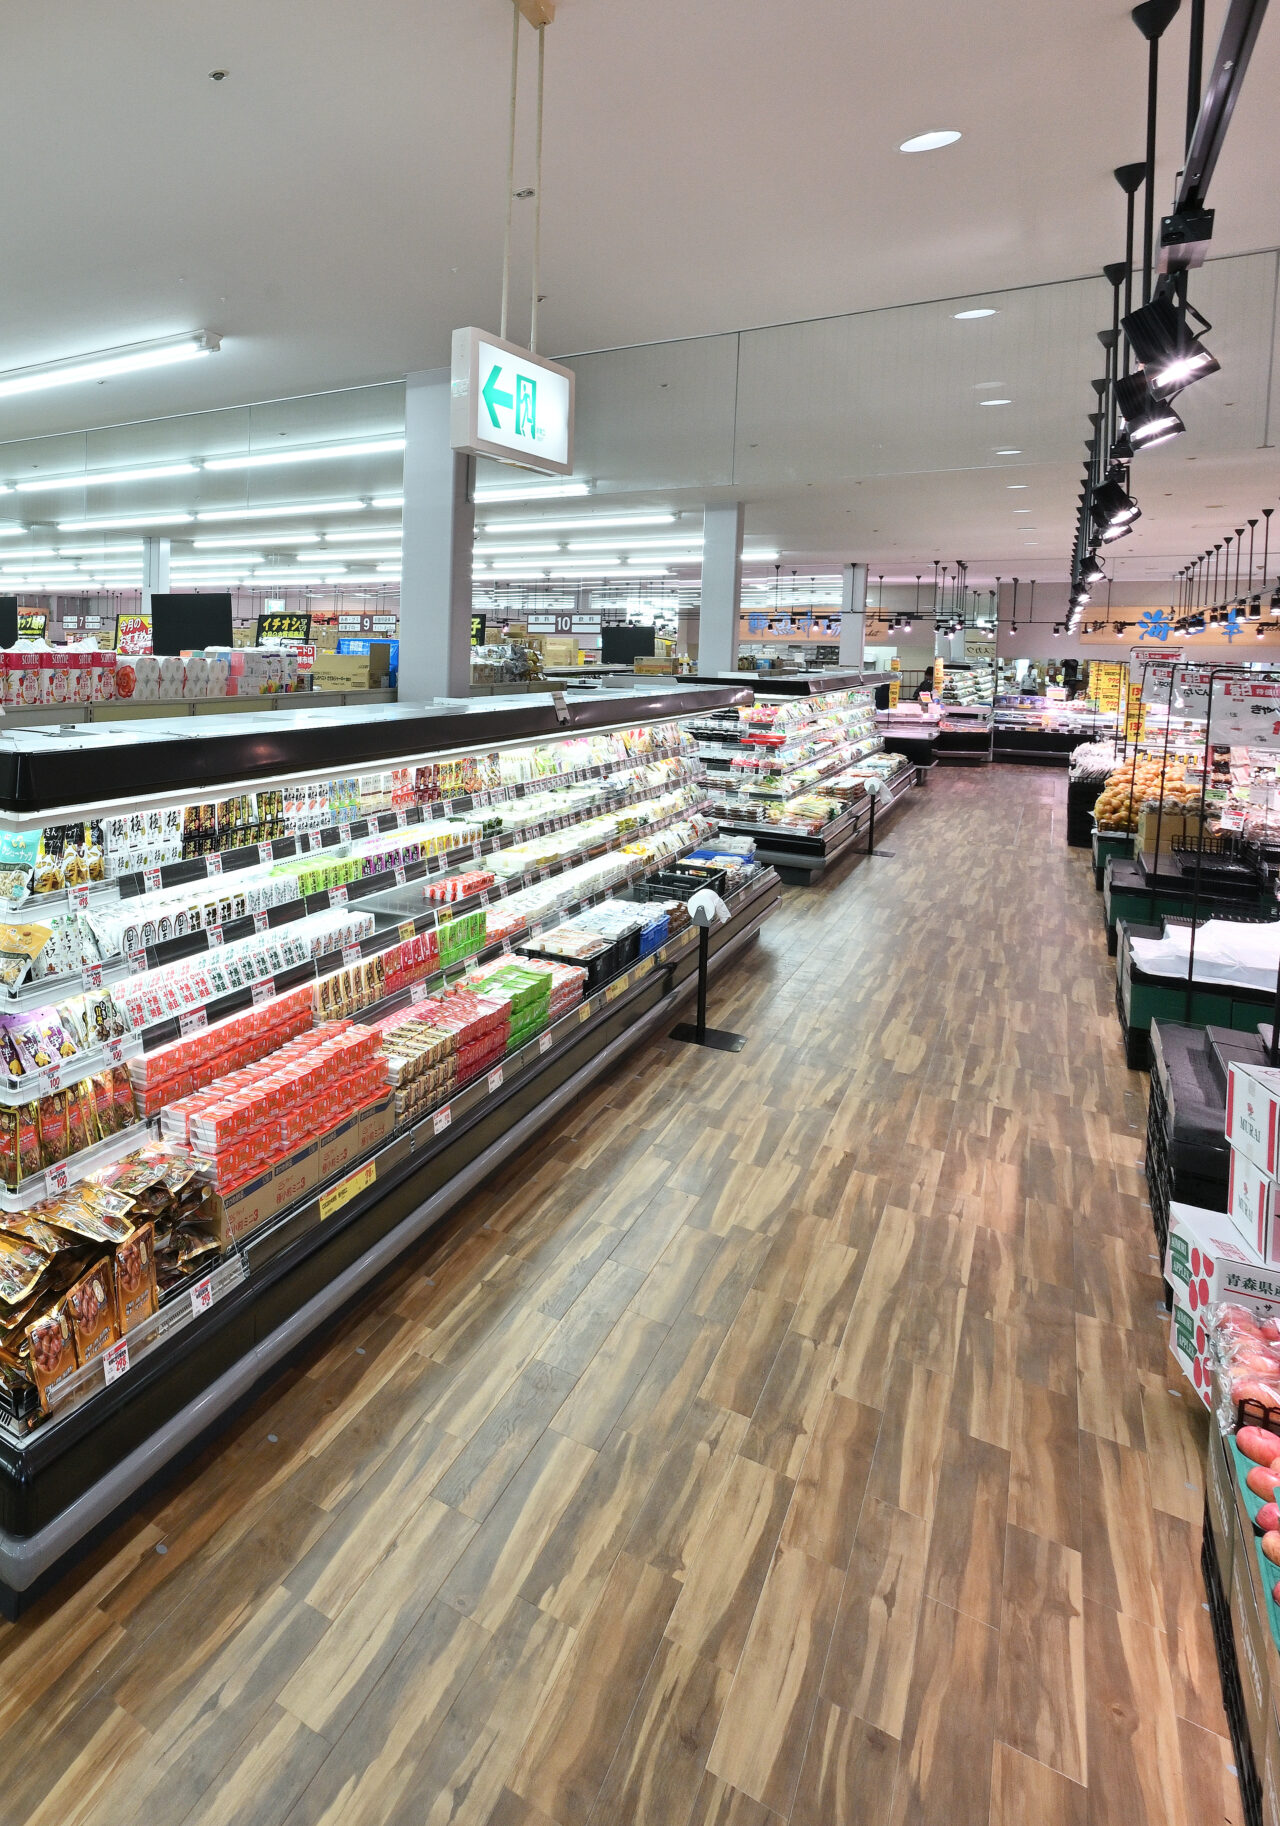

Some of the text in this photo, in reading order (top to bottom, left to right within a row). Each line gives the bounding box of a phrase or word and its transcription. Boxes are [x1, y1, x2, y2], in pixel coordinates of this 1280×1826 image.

[120, 618, 141, 633] 今月の
[262, 618, 301, 631] イチオシ
[363, 618, 370, 630] 9
[557, 616, 570, 631] 10
[49, 1075, 61, 1089] 100
[1239, 1115, 1262, 1144] MURAI
[56, 1174, 68, 1188] 100
[1237, 1193, 1254, 1224] MURAI
[115, 1355, 127, 1372] 298
